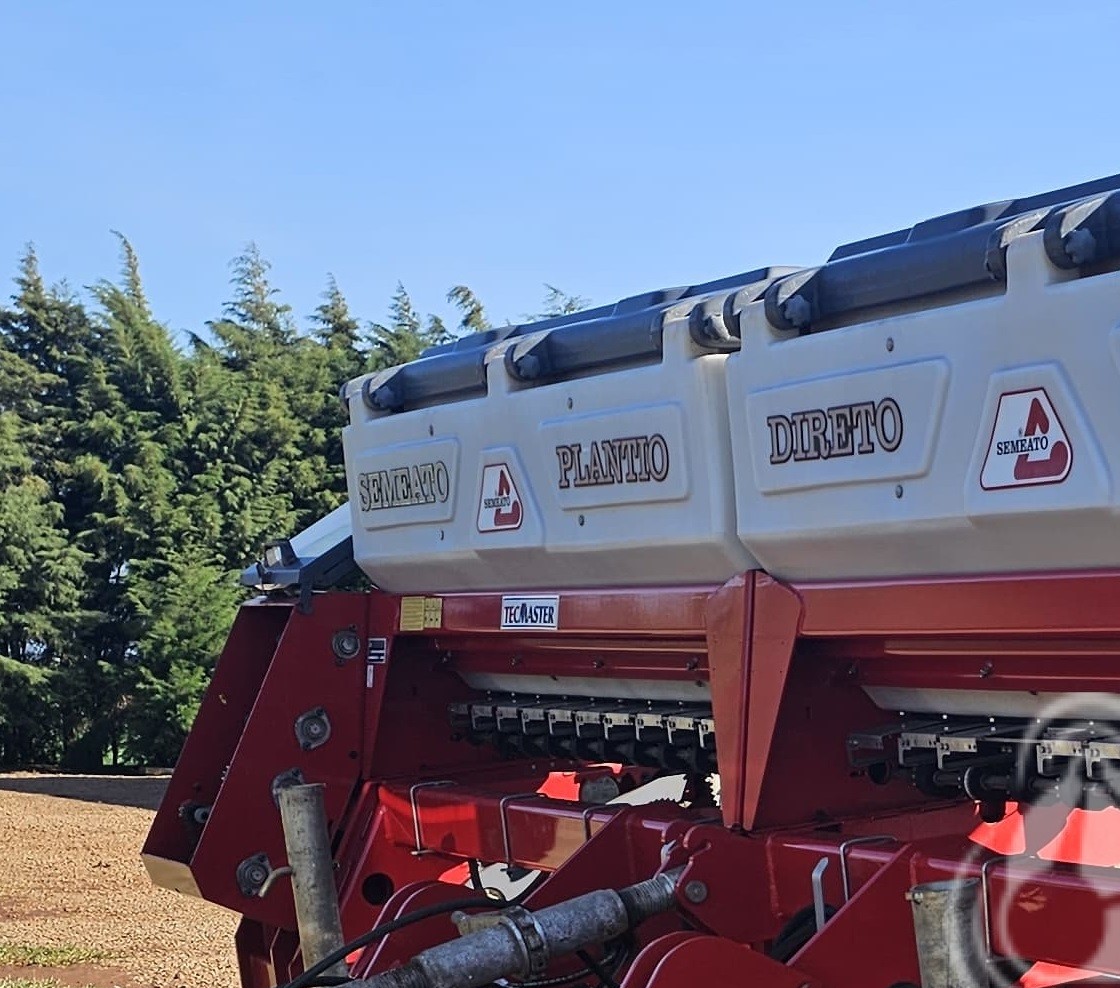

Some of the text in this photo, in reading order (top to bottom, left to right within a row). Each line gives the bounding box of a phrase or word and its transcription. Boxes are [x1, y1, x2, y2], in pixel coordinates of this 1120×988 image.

[767, 397, 904, 465] DIRETO
[996, 435, 1049, 456] SEMEATO
[358, 460, 450, 512] SEMEATO
[556, 433, 670, 490] PLANTIO
[503, 602, 555, 624] TECMASTER
